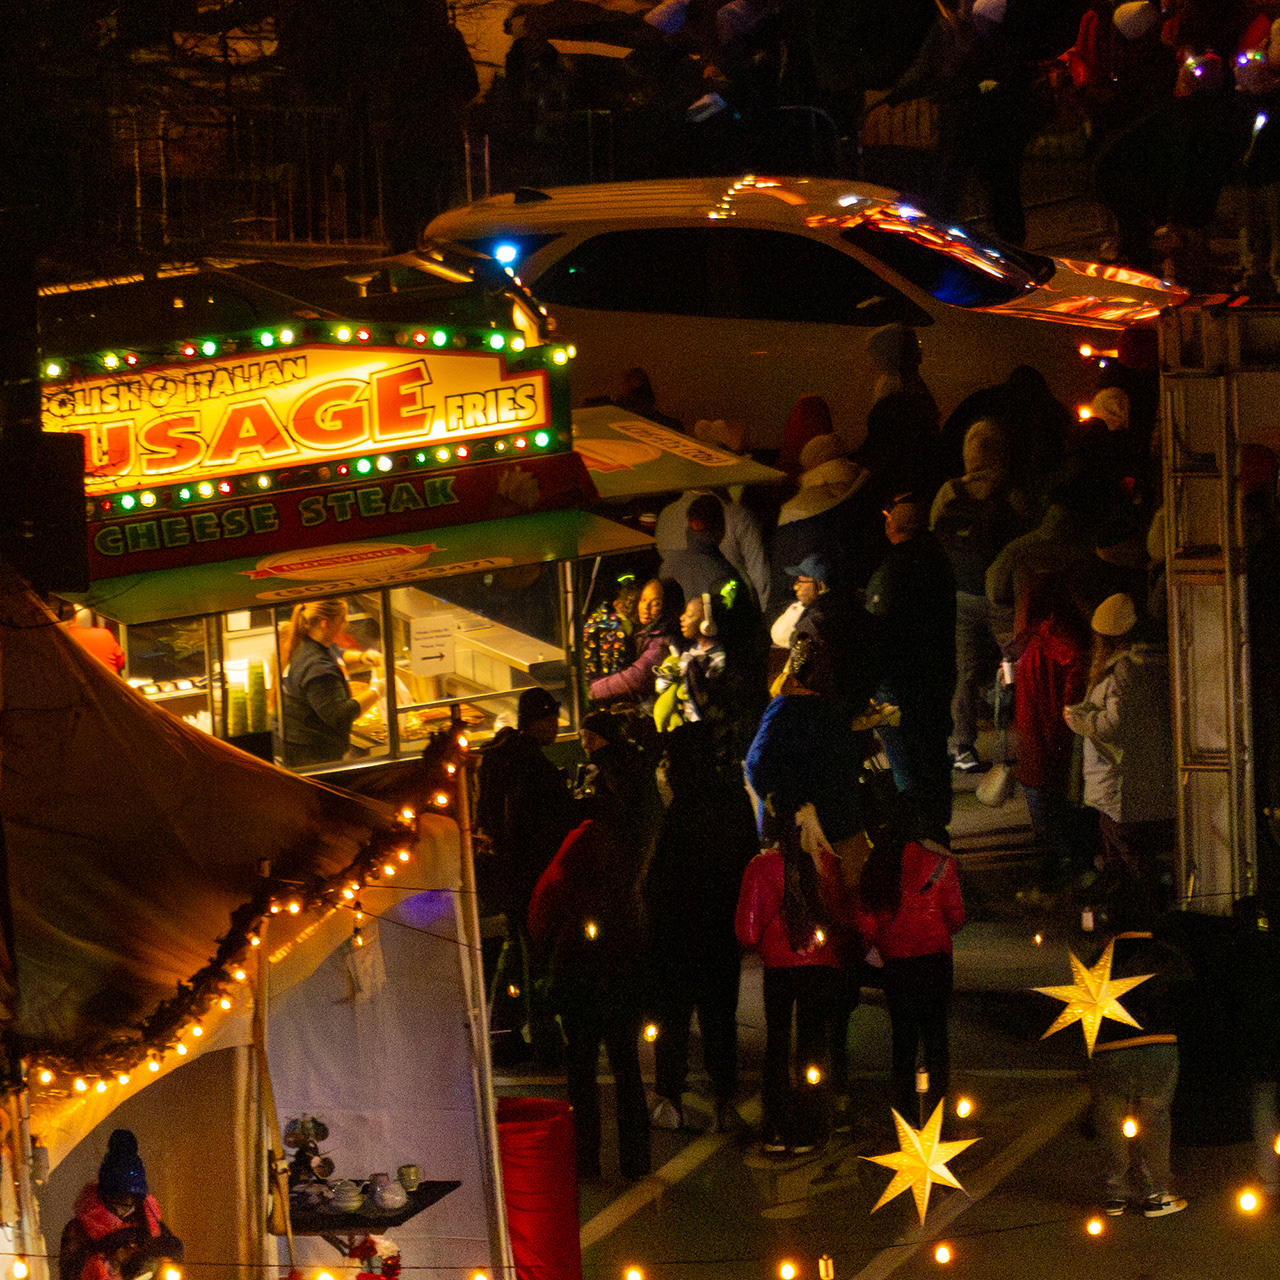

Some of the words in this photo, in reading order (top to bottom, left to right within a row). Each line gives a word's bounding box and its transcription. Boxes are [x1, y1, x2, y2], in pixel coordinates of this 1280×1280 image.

[41, 382, 141, 417] OLISH
[147, 378, 178, 408] &
[185, 356, 308, 404] ITALIAN
[445, 384, 538, 432] FRIES
[93, 502, 280, 556] CHEESE
[298, 476, 460, 528] STEAK
